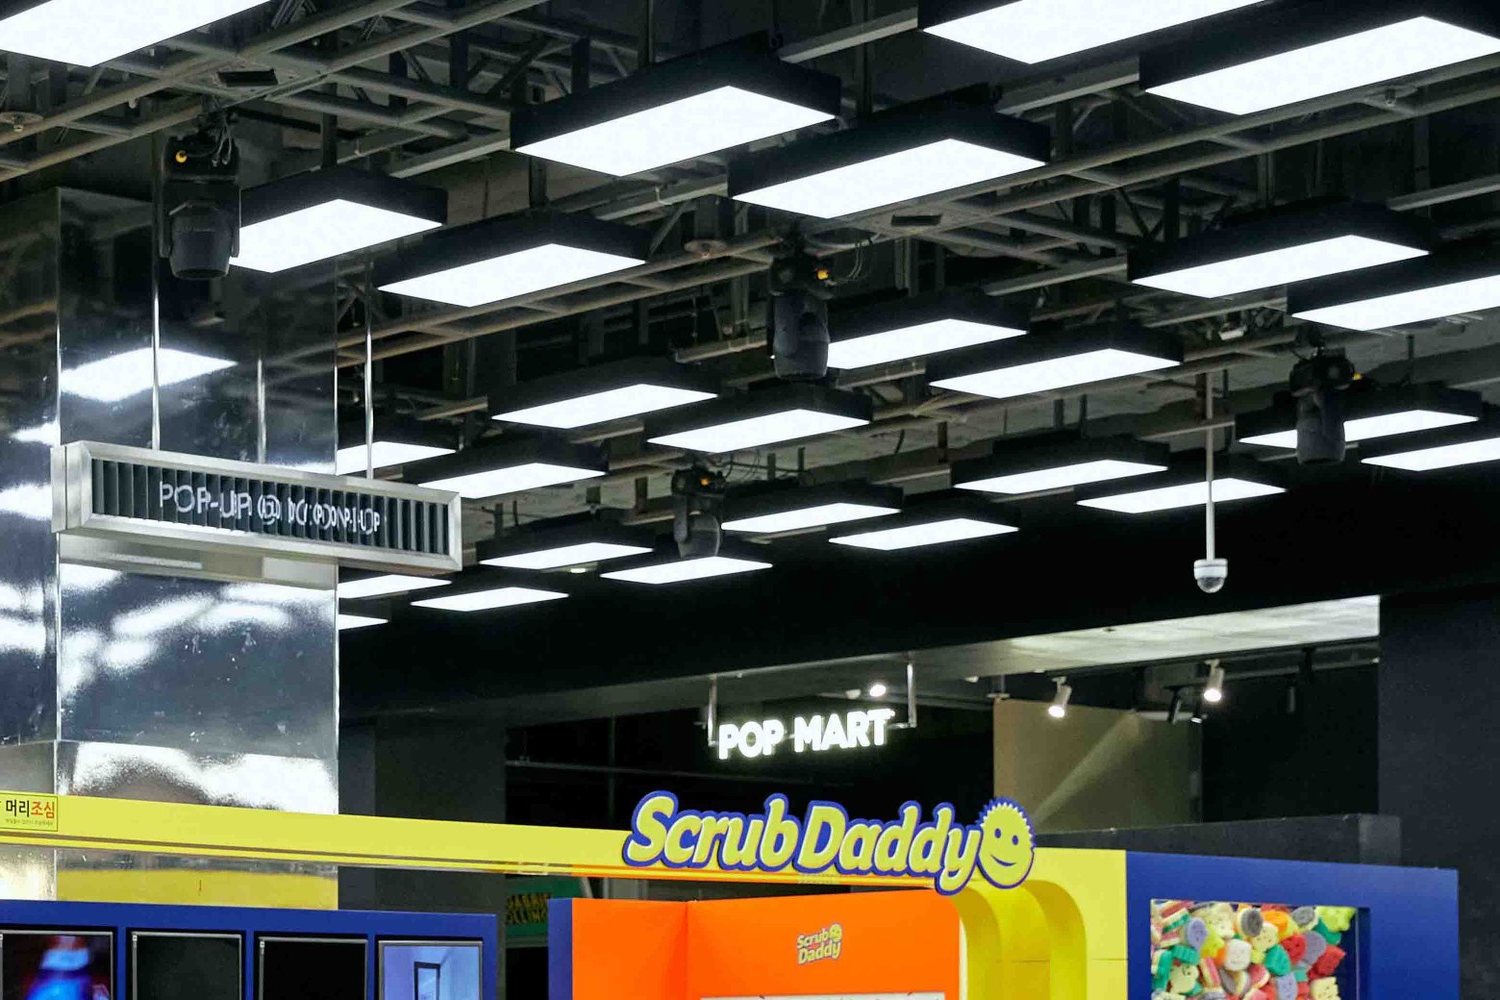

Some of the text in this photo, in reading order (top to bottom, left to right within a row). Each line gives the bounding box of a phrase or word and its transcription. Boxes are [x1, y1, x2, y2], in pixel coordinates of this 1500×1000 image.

[718, 708, 896, 759] POP MART
[5, 799, 55, 819] 머리조심
[624, 793, 981, 892] Scrub Daddy
[797, 928, 830, 949] Scrub
[798, 940, 842, 964] Daddy
